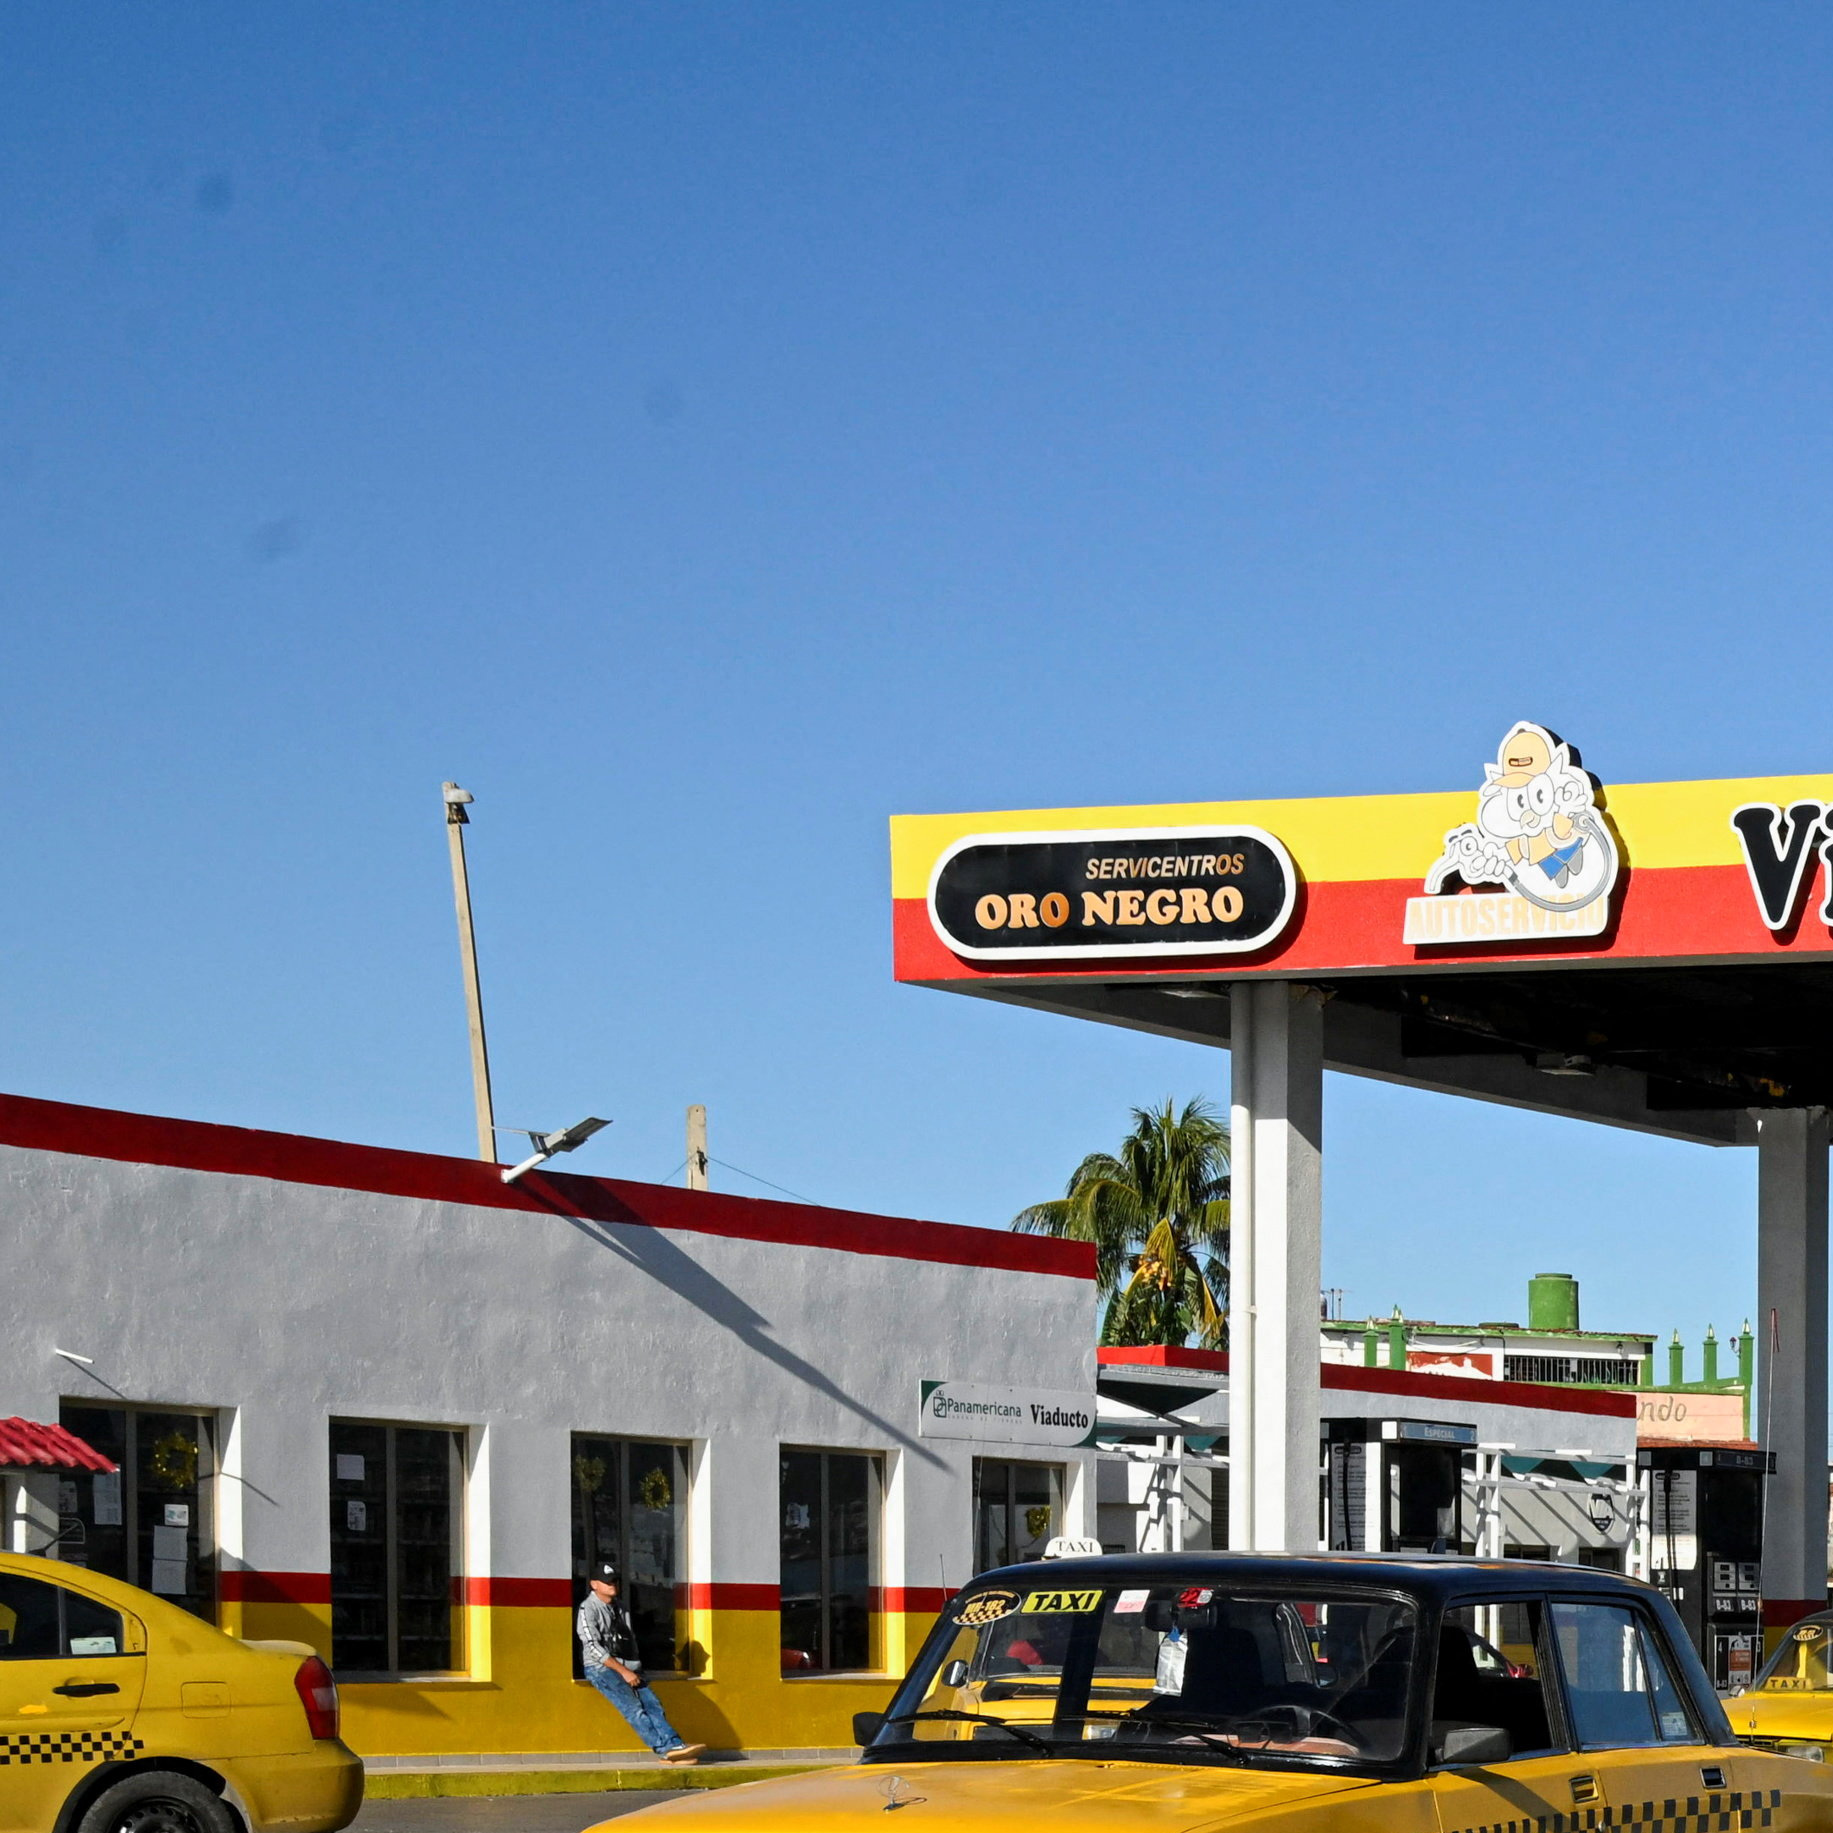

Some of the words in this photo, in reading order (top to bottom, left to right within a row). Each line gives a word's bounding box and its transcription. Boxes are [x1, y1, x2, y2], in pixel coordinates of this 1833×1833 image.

[1085, 853, 1245, 880] SERVICENTROS
[974, 891, 1070, 930] ORO
[1081, 885, 1244, 927] NEGRO
[947, 1397, 1022, 1417] Panamericana
[1030, 1403, 1089, 1429] Viaducto
[1055, 1540, 1094, 1553] TAXI
[1032, 1592, 1096, 1611] TAXI
[1770, 1679, 1806, 1689] TAXI
